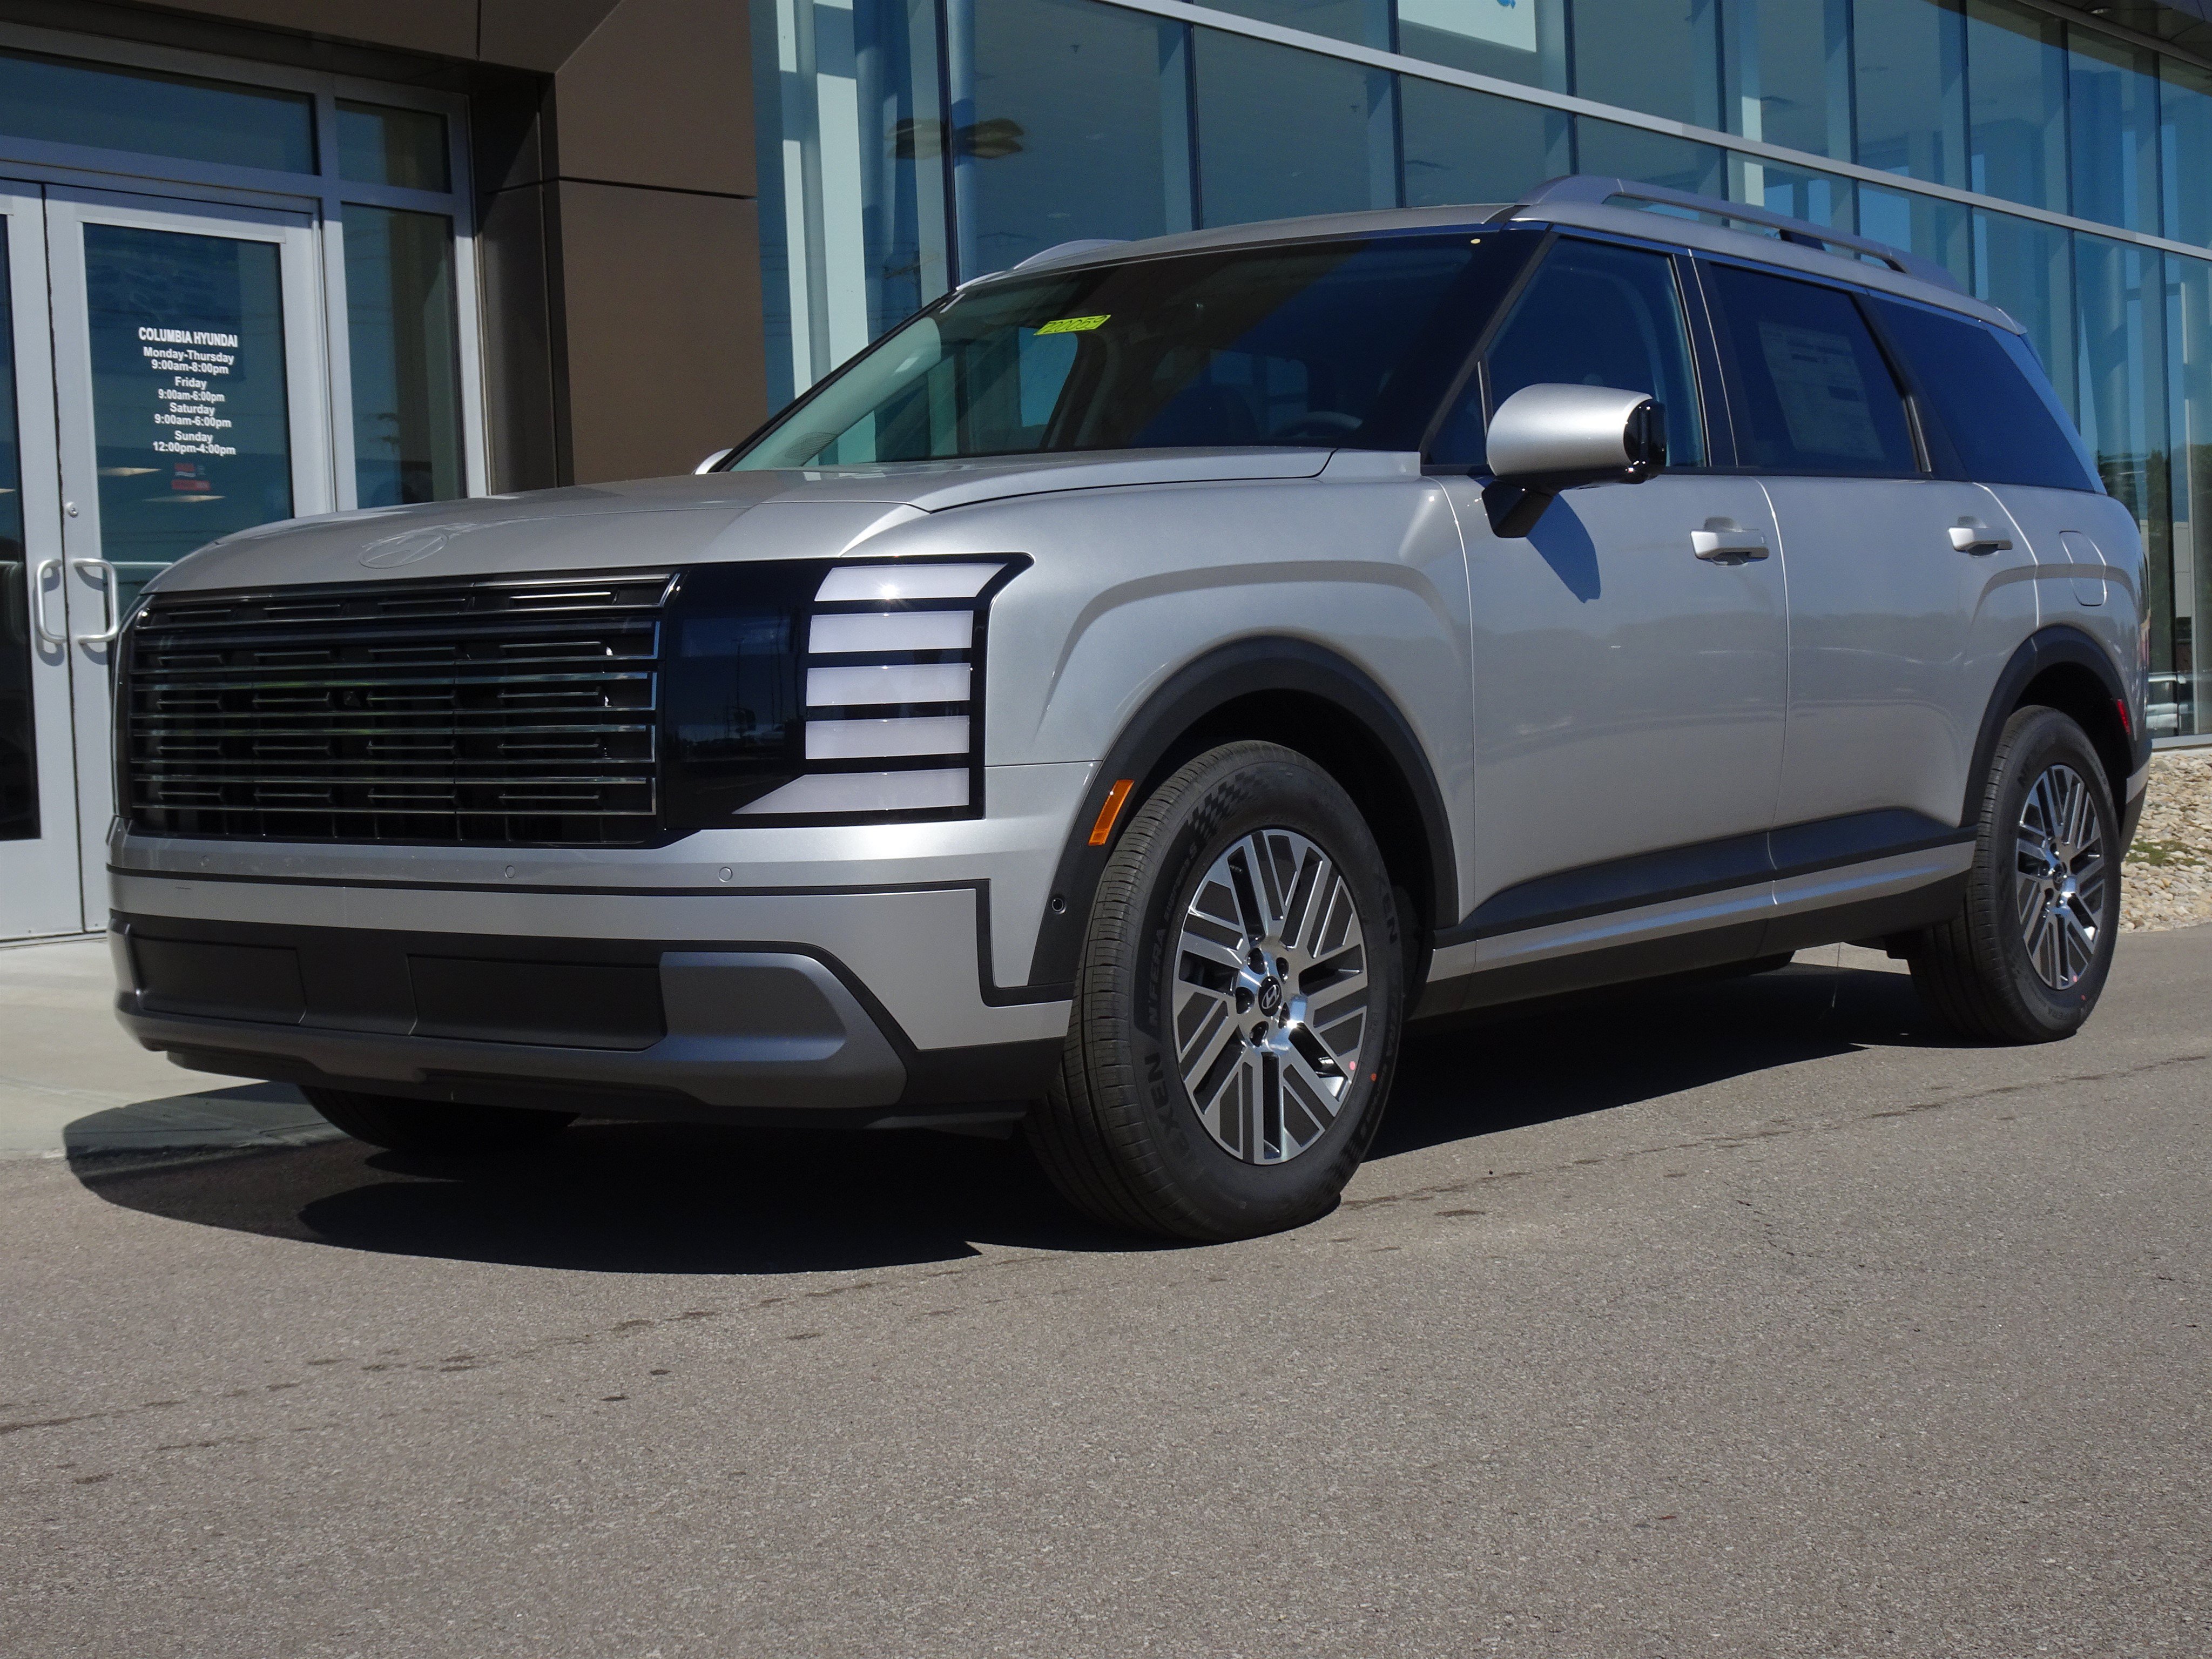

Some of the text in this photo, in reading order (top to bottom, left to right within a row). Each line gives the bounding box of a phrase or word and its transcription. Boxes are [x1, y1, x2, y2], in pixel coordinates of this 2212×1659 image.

[139, 327, 238, 347] COLUMBIA HYUNDAI
[143, 347, 234, 365] Monday-Thursday
[151, 359, 229, 375] 9:00am-8:00pm
[174, 376, 207, 390] Friday
[158, 389, 225, 403] 9:00am-6:00pm
[170, 402, 215, 416] Saturday
[154, 414, 232, 429] 9:00am-6:00pm
[174, 430, 213, 444] Sunday
[153, 441, 236, 456] 12:00pm-4:00pm
